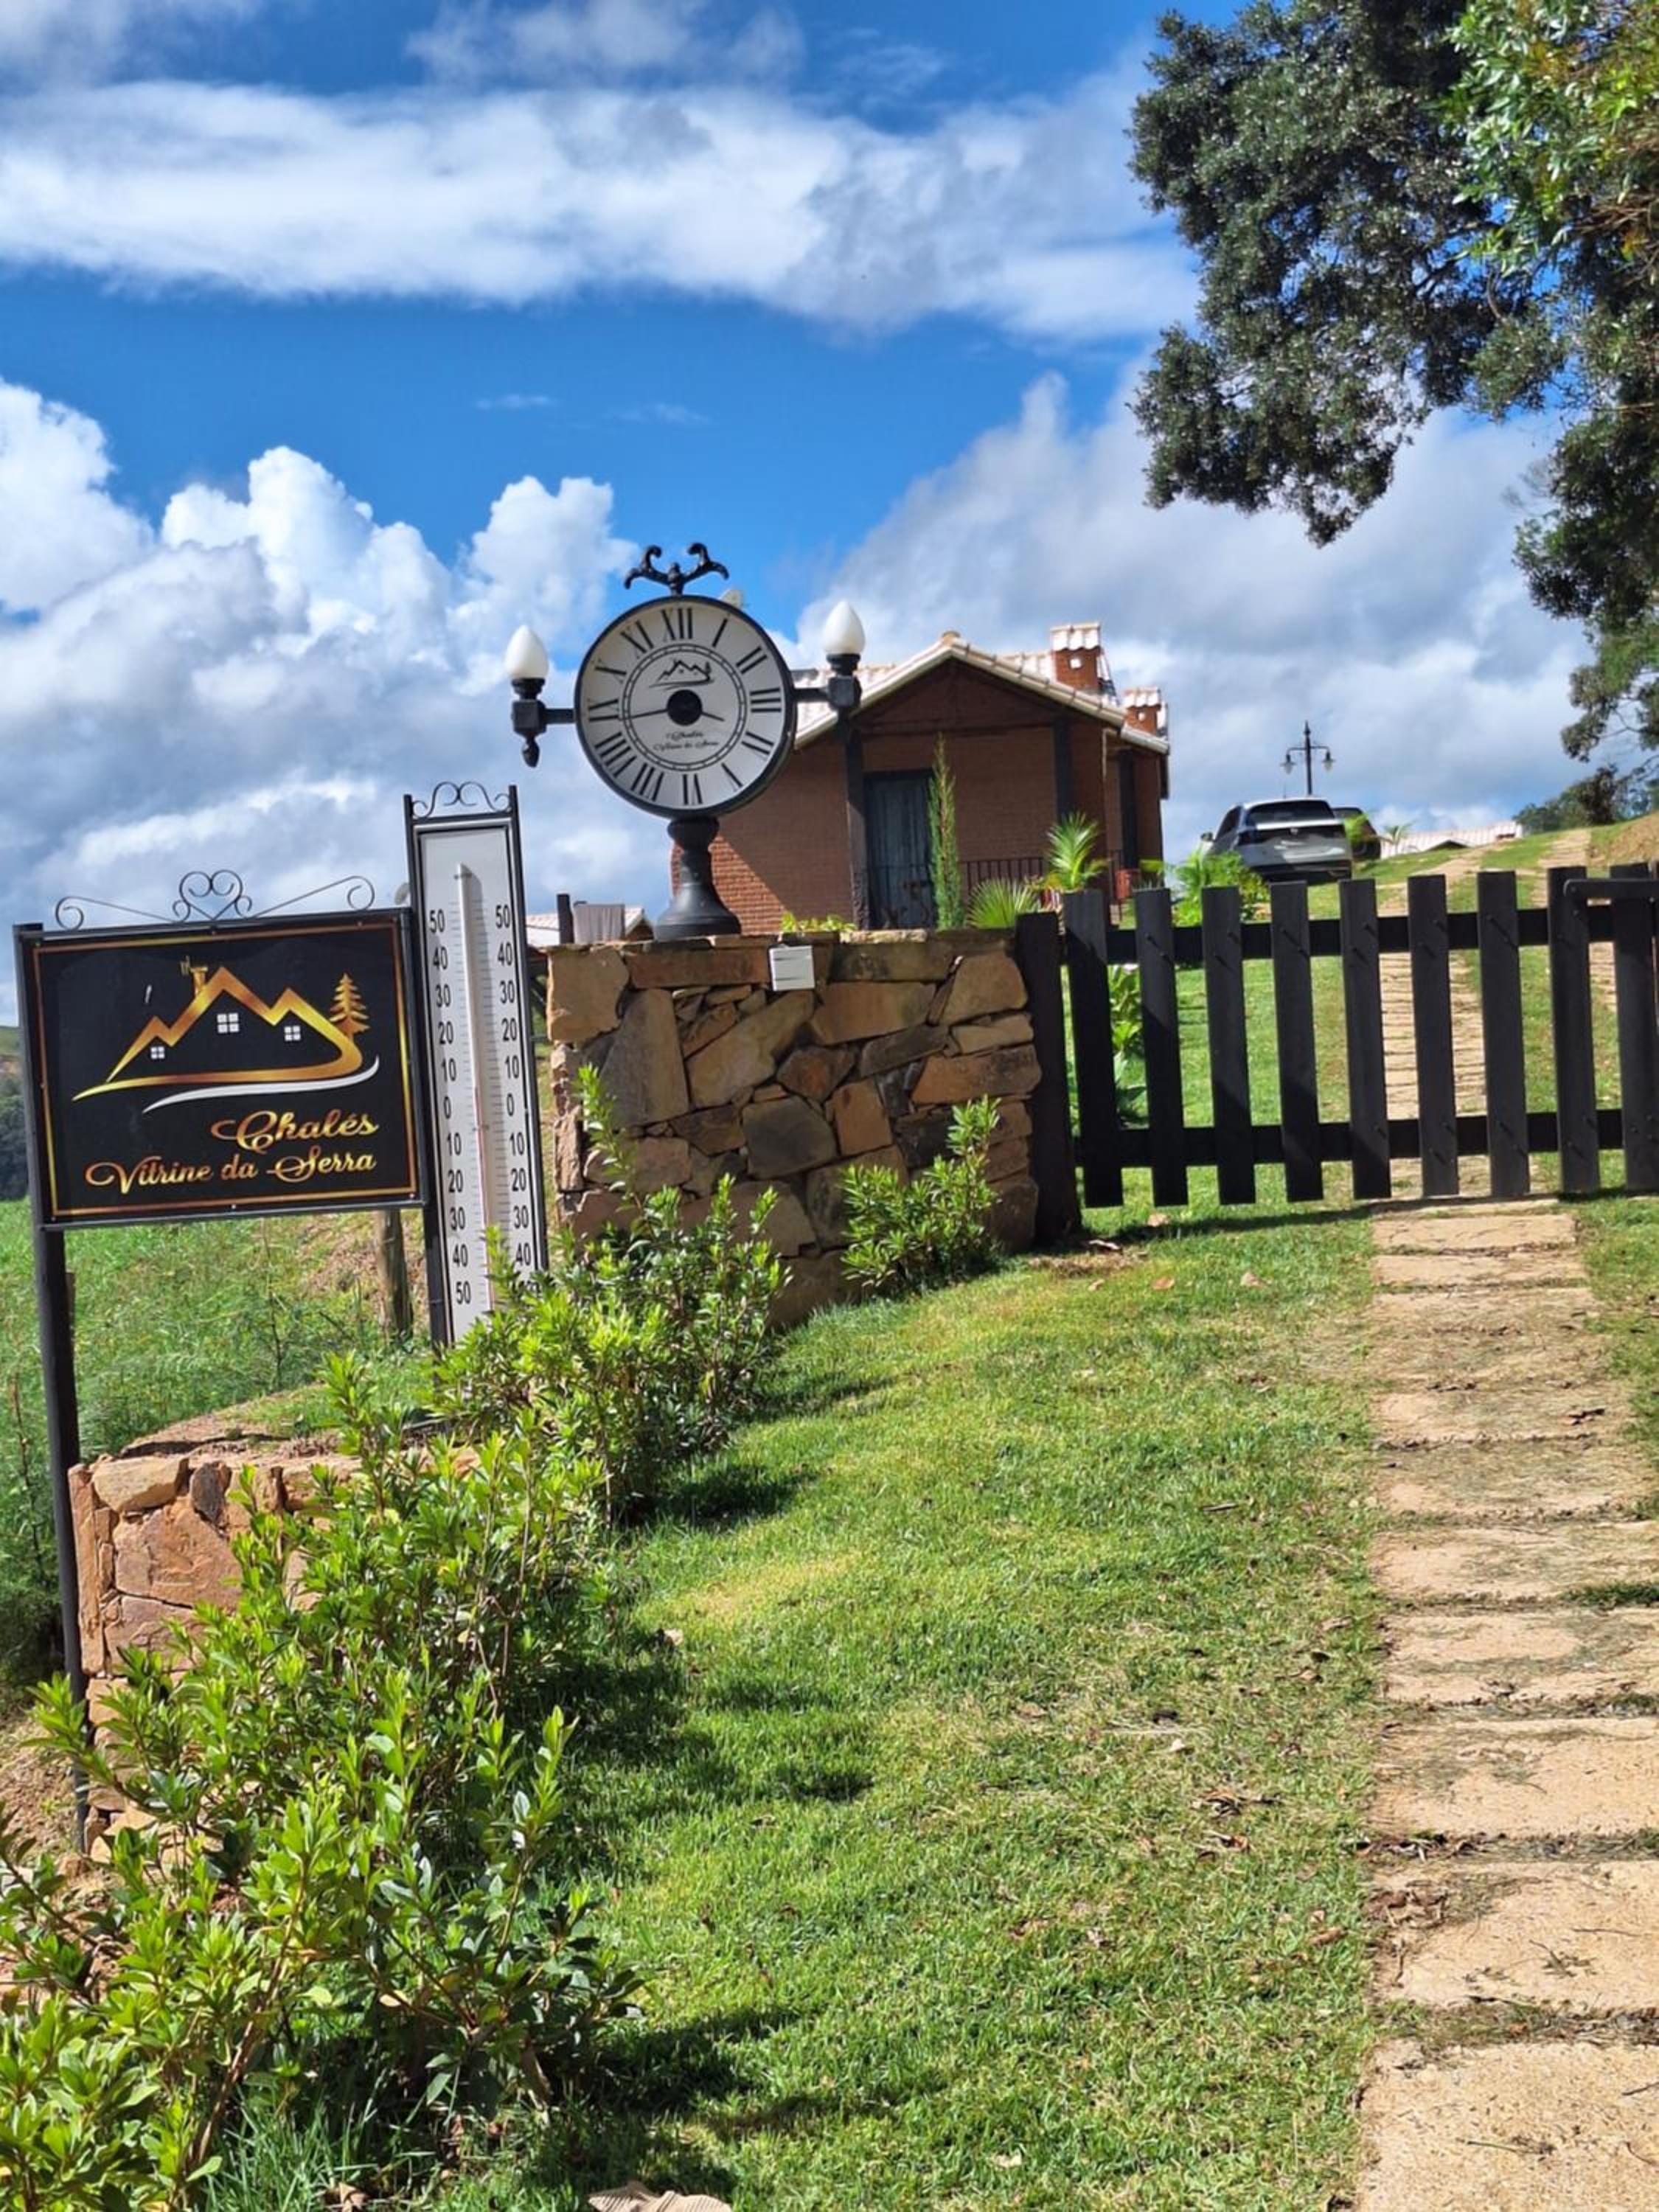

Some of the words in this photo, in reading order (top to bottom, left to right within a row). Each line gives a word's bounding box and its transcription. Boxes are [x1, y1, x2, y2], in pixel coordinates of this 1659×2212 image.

[749, 686, 782, 713] III
[430, 909, 445, 933] 50
[495, 905, 510, 928] 50
[433, 947, 448, 970] 40
[498, 942, 512, 966] 40
[435, 984, 451, 1007] 30
[500, 980, 515, 1004] 30
[438, 1021, 453, 1045] 20
[502, 1018, 518, 1041] 20
[441, 1058, 456, 1082] 10
[504, 1055, 519, 1079] 10
[444, 1096, 451, 1119] 0
[507, 1093, 515, 1116] 0
[211, 1109, 379, 1153] Chalés
[447, 1133, 462, 1155] 10
[509, 1132, 524, 1155] 10
[85, 1155, 212, 1194] Vitrine
[221, 1153, 258, 1180] da
[266, 1144, 376, 1182] Serra
[448, 1169, 464, 1192] 20
[511, 1168, 526, 1192] 20
[450, 1207, 465, 1231] 30
[513, 1206, 529, 1228] 30
[453, 1244, 468, 1267] 40
[516, 1242, 531, 1265] 40
[456, 1281, 471, 1304] 50
